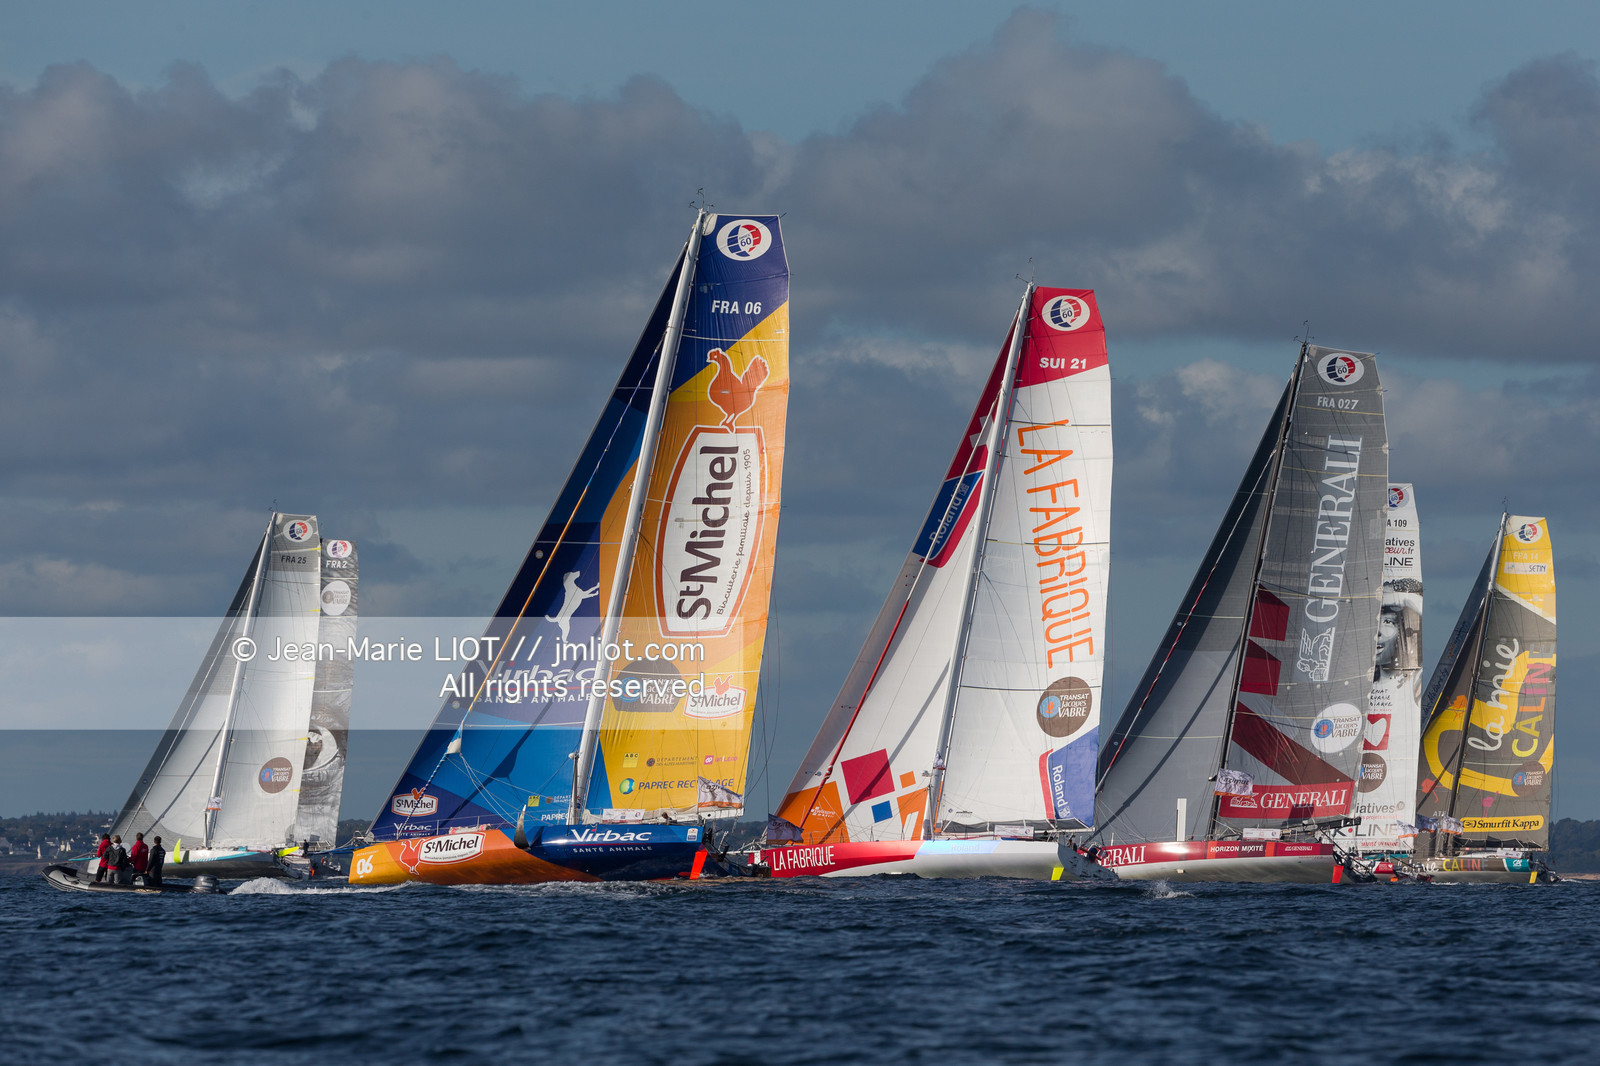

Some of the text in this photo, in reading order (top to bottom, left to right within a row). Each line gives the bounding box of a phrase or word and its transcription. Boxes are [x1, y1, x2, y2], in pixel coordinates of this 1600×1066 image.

[740, 237, 752, 247] 60
[711, 300, 762, 315] FRA 06
[1062, 309, 1073, 319] 60
[1039, 357, 1087, 370] SUI 21
[1337, 366, 1348, 375] 60
[1317, 396, 1359, 410] FRA 027
[743, 448, 751, 470] 1905
[1394, 519, 1408, 527] 109
[1305, 434, 1363, 623] GENERALI
[1017, 419, 1094, 669] LA FABRIQUE
[280, 555, 307, 565] FRA 25
[1513, 552, 1539, 561] FRA 14
[325, 560, 348, 569] FRA 2
[1384, 557, 1414, 567] INE
[1528, 564, 1546, 573] SETIN
[1060, 693, 1089, 701] TRANSAT
[1058, 707, 1088, 718] VABRE
[1331, 728, 1358, 738] VABRE
[638, 780, 675, 790] PAPREC
[1052, 764, 1069, 808] Roland
[1259, 789, 1348, 809] GENERALI
[1476, 819, 1540, 830] Smurfit Kappa
[570, 828, 652, 842] Virbac
[951, 843, 980, 852] Roland
[1210, 845, 1240, 853] HORIZON
[773, 845, 836, 871] LA FABRIQUE
[357, 854, 374, 875] 06
